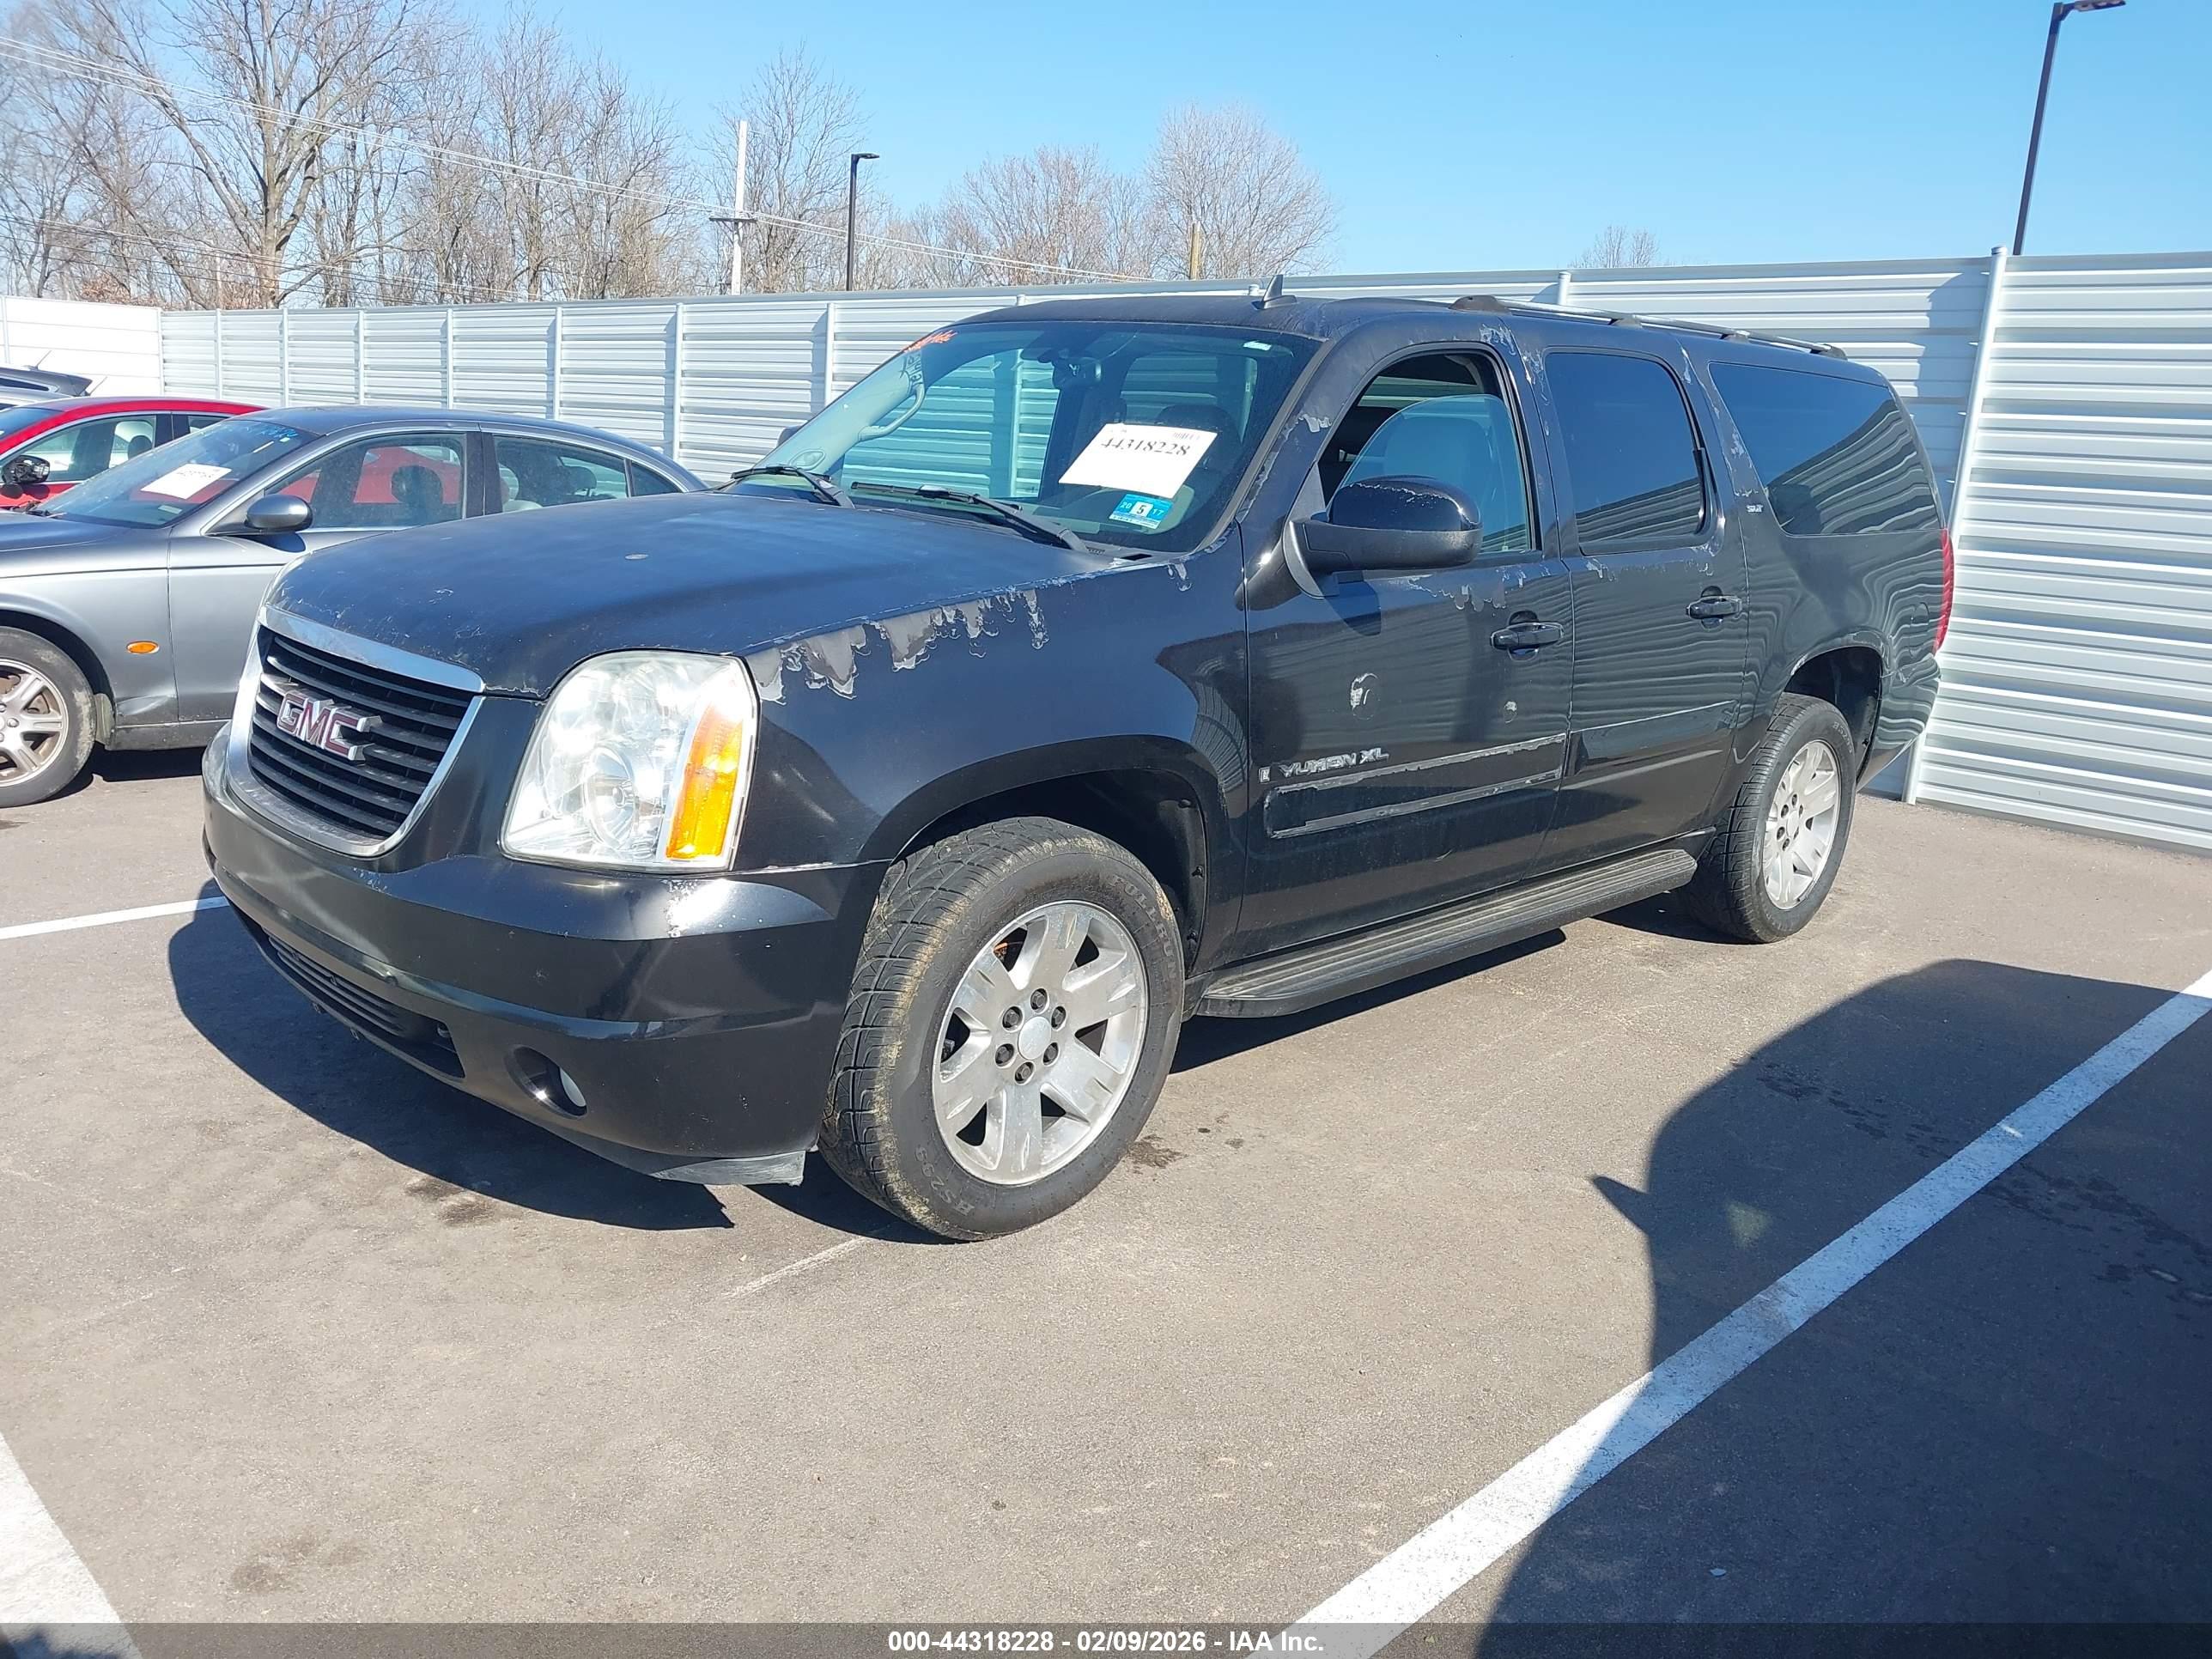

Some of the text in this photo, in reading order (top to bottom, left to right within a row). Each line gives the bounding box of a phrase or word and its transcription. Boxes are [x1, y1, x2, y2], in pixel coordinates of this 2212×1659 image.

[1101, 437, 1191, 456] 44318228
[1136, 505, 1147, 514] 5
[276, 690, 381, 761] GMC
[1278, 747, 1389, 778] YUKON XL
